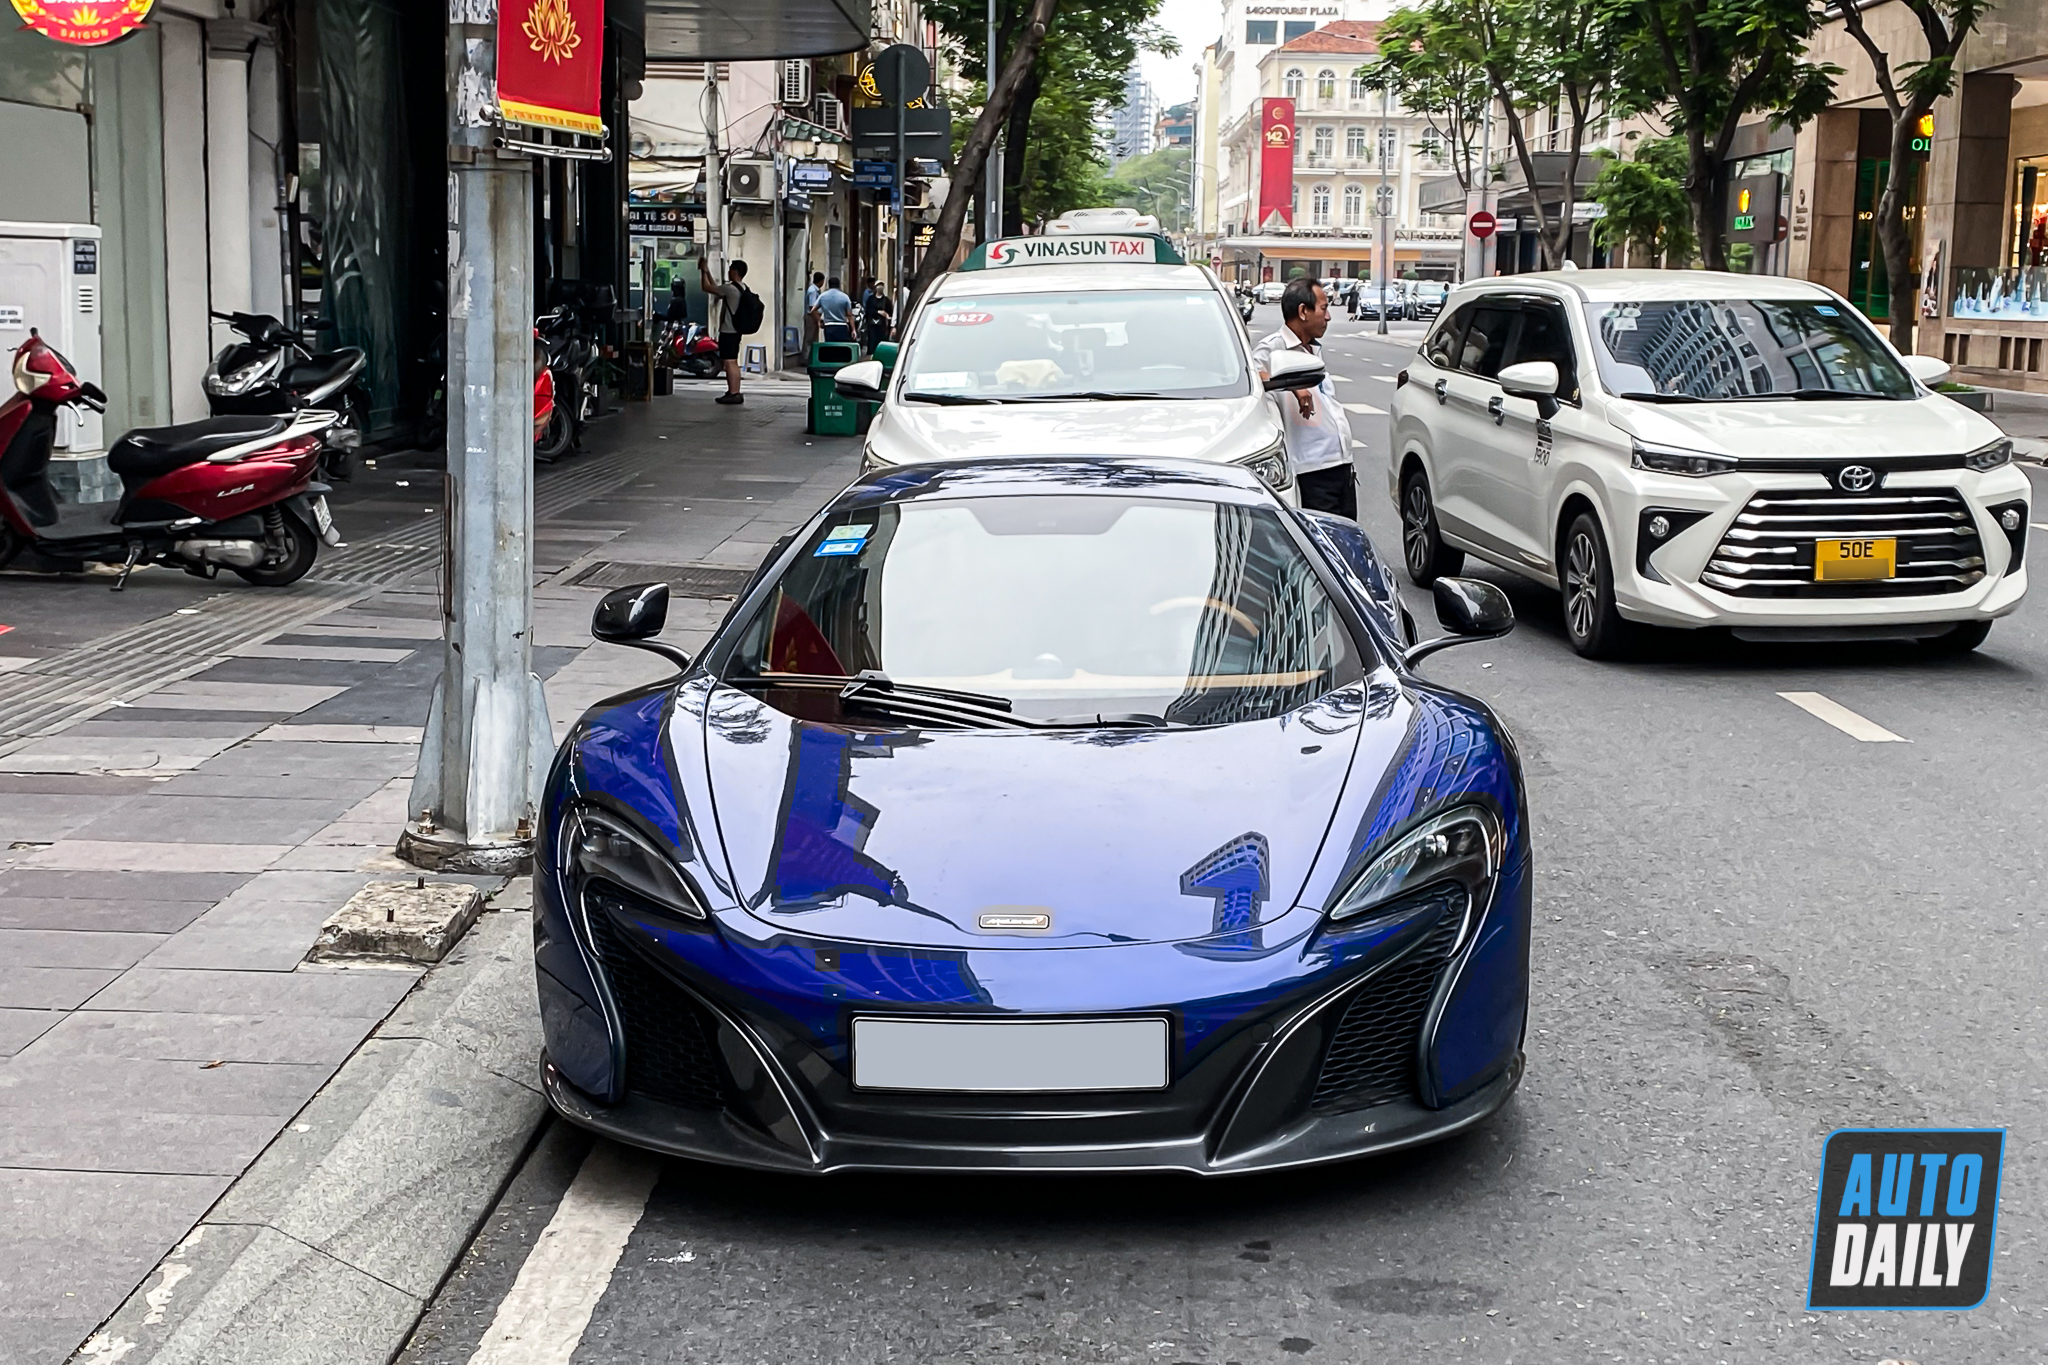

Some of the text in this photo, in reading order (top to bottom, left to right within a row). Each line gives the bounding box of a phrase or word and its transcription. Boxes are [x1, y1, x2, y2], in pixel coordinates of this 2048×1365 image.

[1246, 6, 1339, 15] SAIGONTOURIST PLAZA
[60, 28, 109, 39] SAIGON
[1266, 131, 1283, 142] 142
[1025, 241, 1144, 258] VINASUN TAXI
[1840, 541, 1874, 558] 50E
